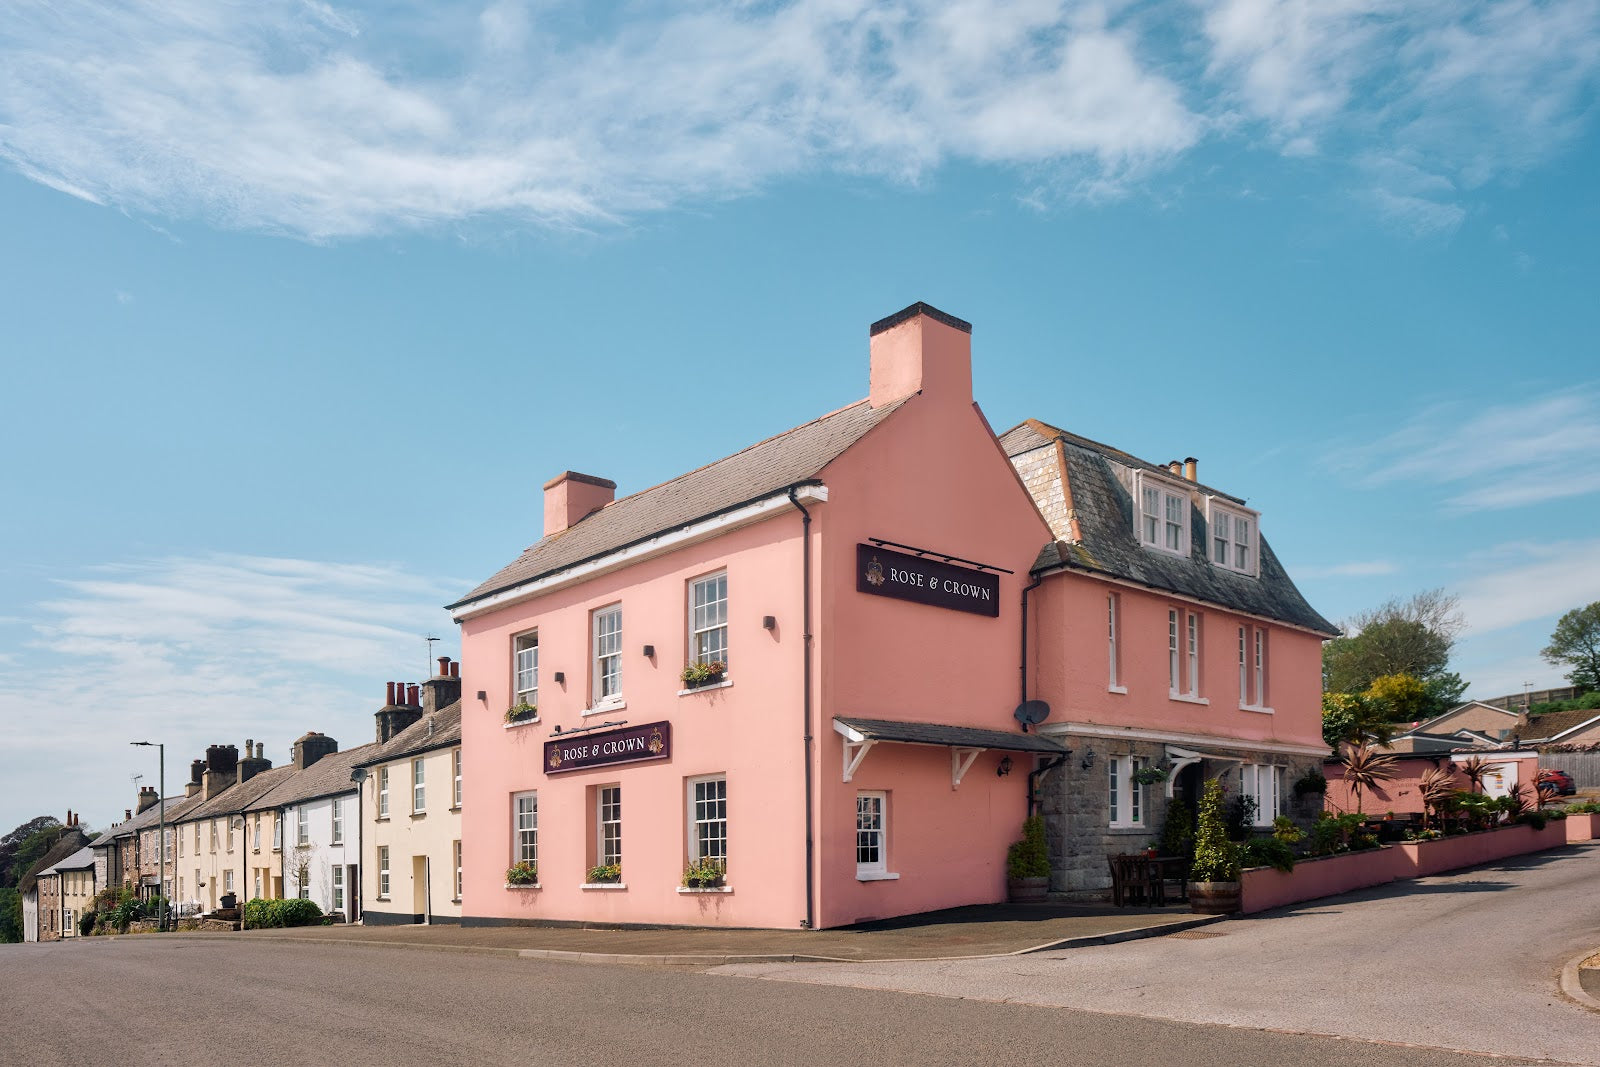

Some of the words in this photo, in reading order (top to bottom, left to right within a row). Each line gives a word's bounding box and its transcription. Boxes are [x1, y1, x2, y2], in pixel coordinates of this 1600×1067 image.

[890, 568, 924, 587] ROSE
[930, 576, 938, 590] &
[944, 580, 990, 600] CROWN
[564, 746, 588, 760] ROSE
[592, 744, 600, 756] &
[604, 736, 645, 754] CROWN
